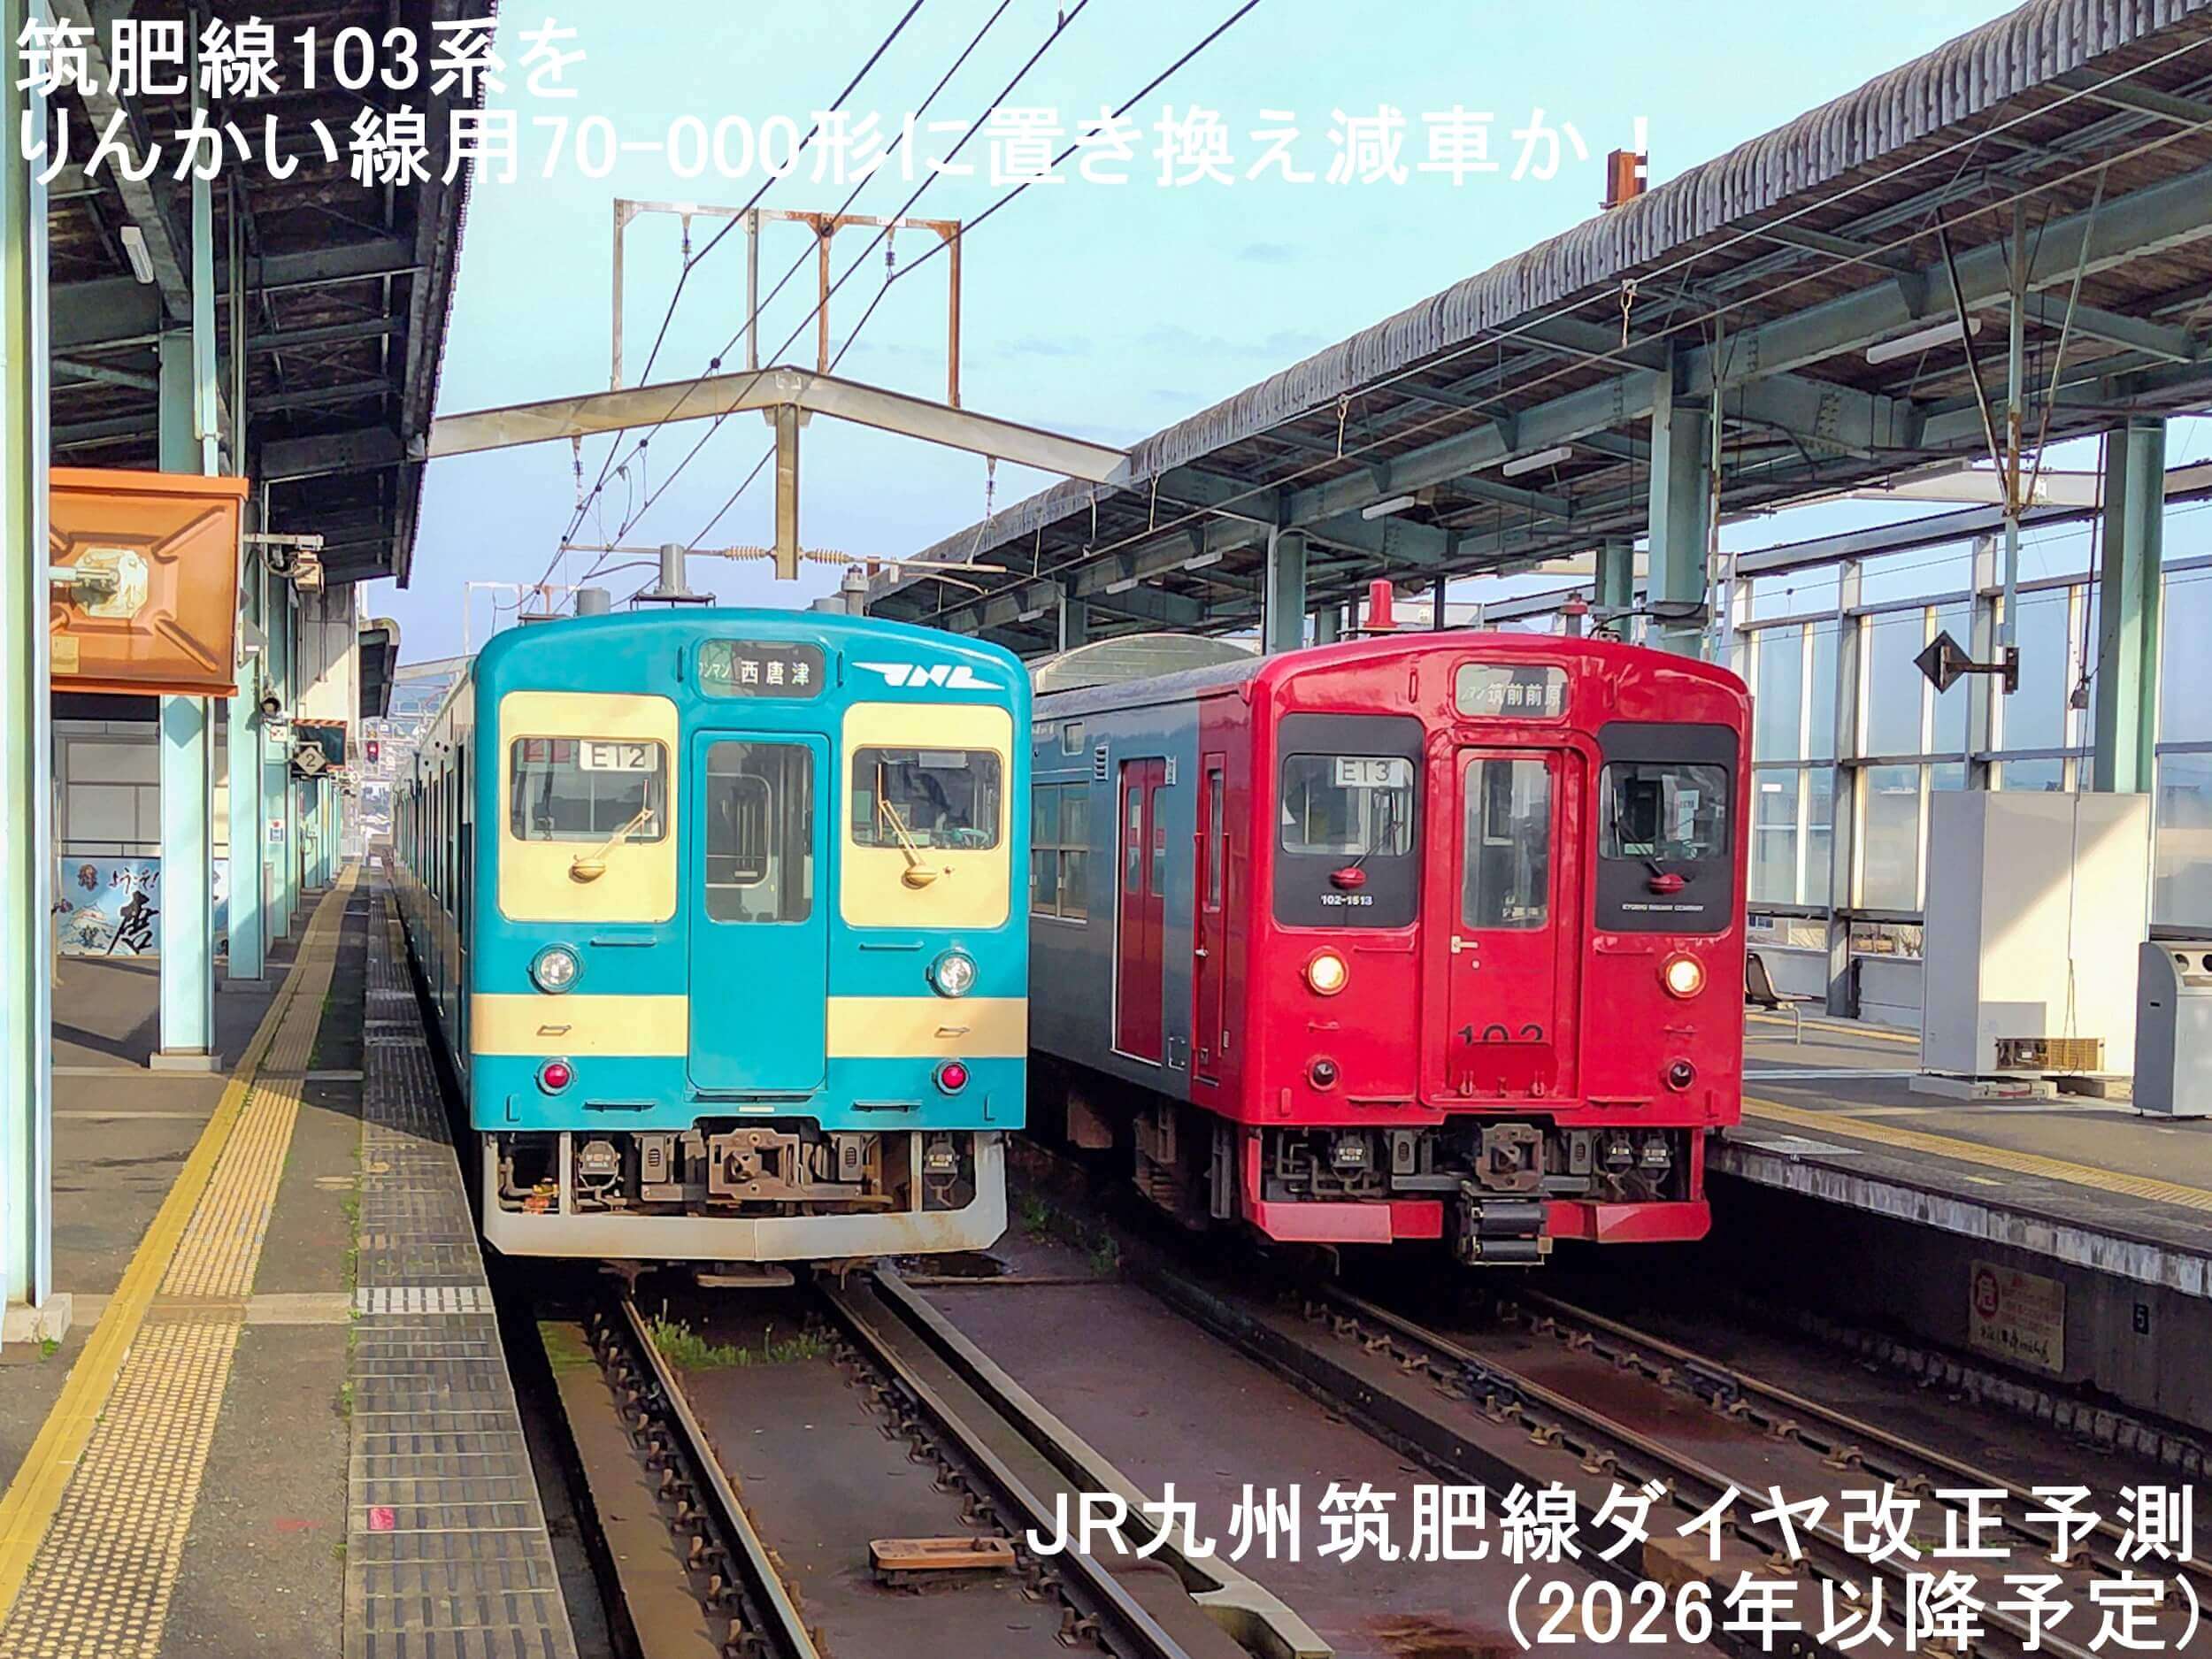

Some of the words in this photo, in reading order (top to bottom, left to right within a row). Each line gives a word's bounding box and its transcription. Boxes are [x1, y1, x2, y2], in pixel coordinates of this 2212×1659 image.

[741, 660, 810, 686] 西唐津
[1487, 682, 1563, 707] 筑前前原
[305, 753, 316, 767] 2
[591, 745, 646, 768] E12
[1343, 761, 1390, 782] E13
[1320, 895, 1373, 906] 102-1513
[2134, 1306, 2147, 1329] 5
